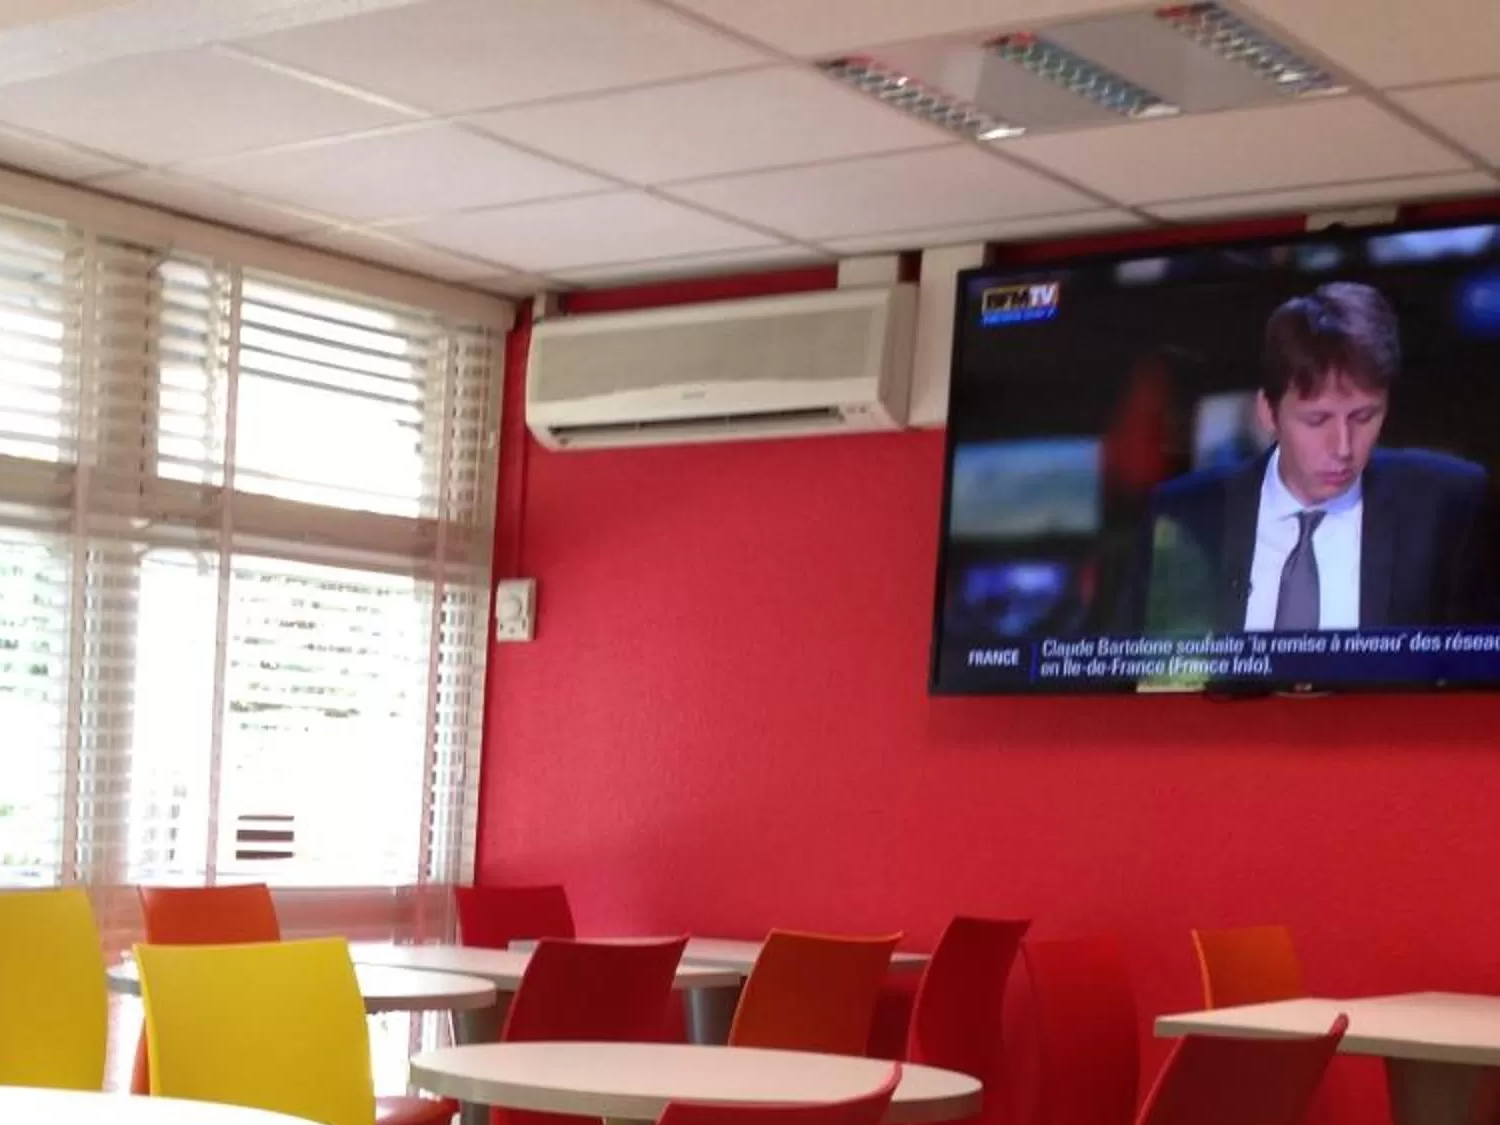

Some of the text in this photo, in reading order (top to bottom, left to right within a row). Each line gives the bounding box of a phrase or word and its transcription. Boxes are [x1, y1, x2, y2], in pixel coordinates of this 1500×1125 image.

[1041, 638, 1095, 657] Claude
[1097, 635, 1173, 657] Bartolone
[1176, 633, 1245, 655] souhaite
[1270, 633, 1327, 654] remise
[1330, 633, 1341, 653] à
[1409, 631, 1441, 652] des
[967, 648, 1020, 667] FRANCE
[1040, 660, 1060, 678] en
[1167, 655, 1230, 677] (France
